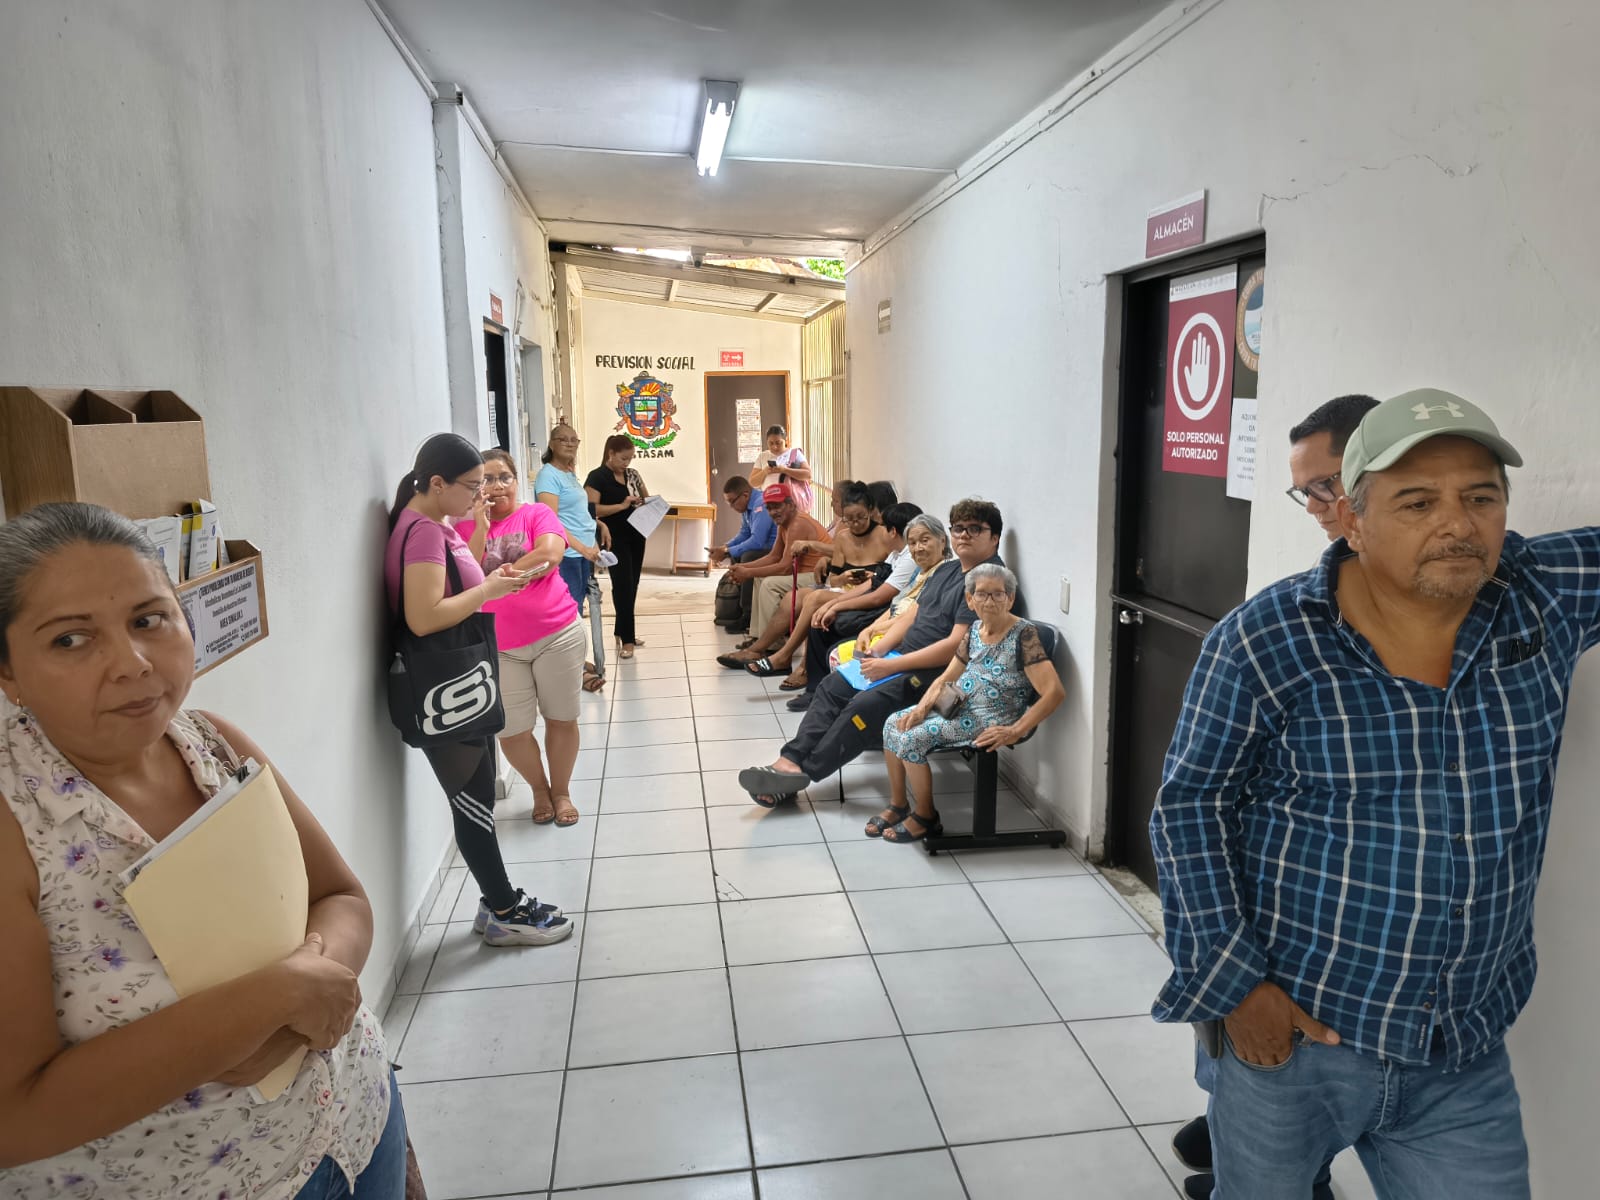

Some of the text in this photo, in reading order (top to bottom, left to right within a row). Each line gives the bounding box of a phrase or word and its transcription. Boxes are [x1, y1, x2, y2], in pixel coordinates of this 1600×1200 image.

[1153, 212, 1194, 241] ALMACÉN
[595, 355, 695, 370] PREVISION SOCIAL
[1166, 431, 1225, 445] SOLO PERSONAL
[632, 449, 675, 459] TASAM
[1171, 447, 1218, 461] AUTORIZADO
